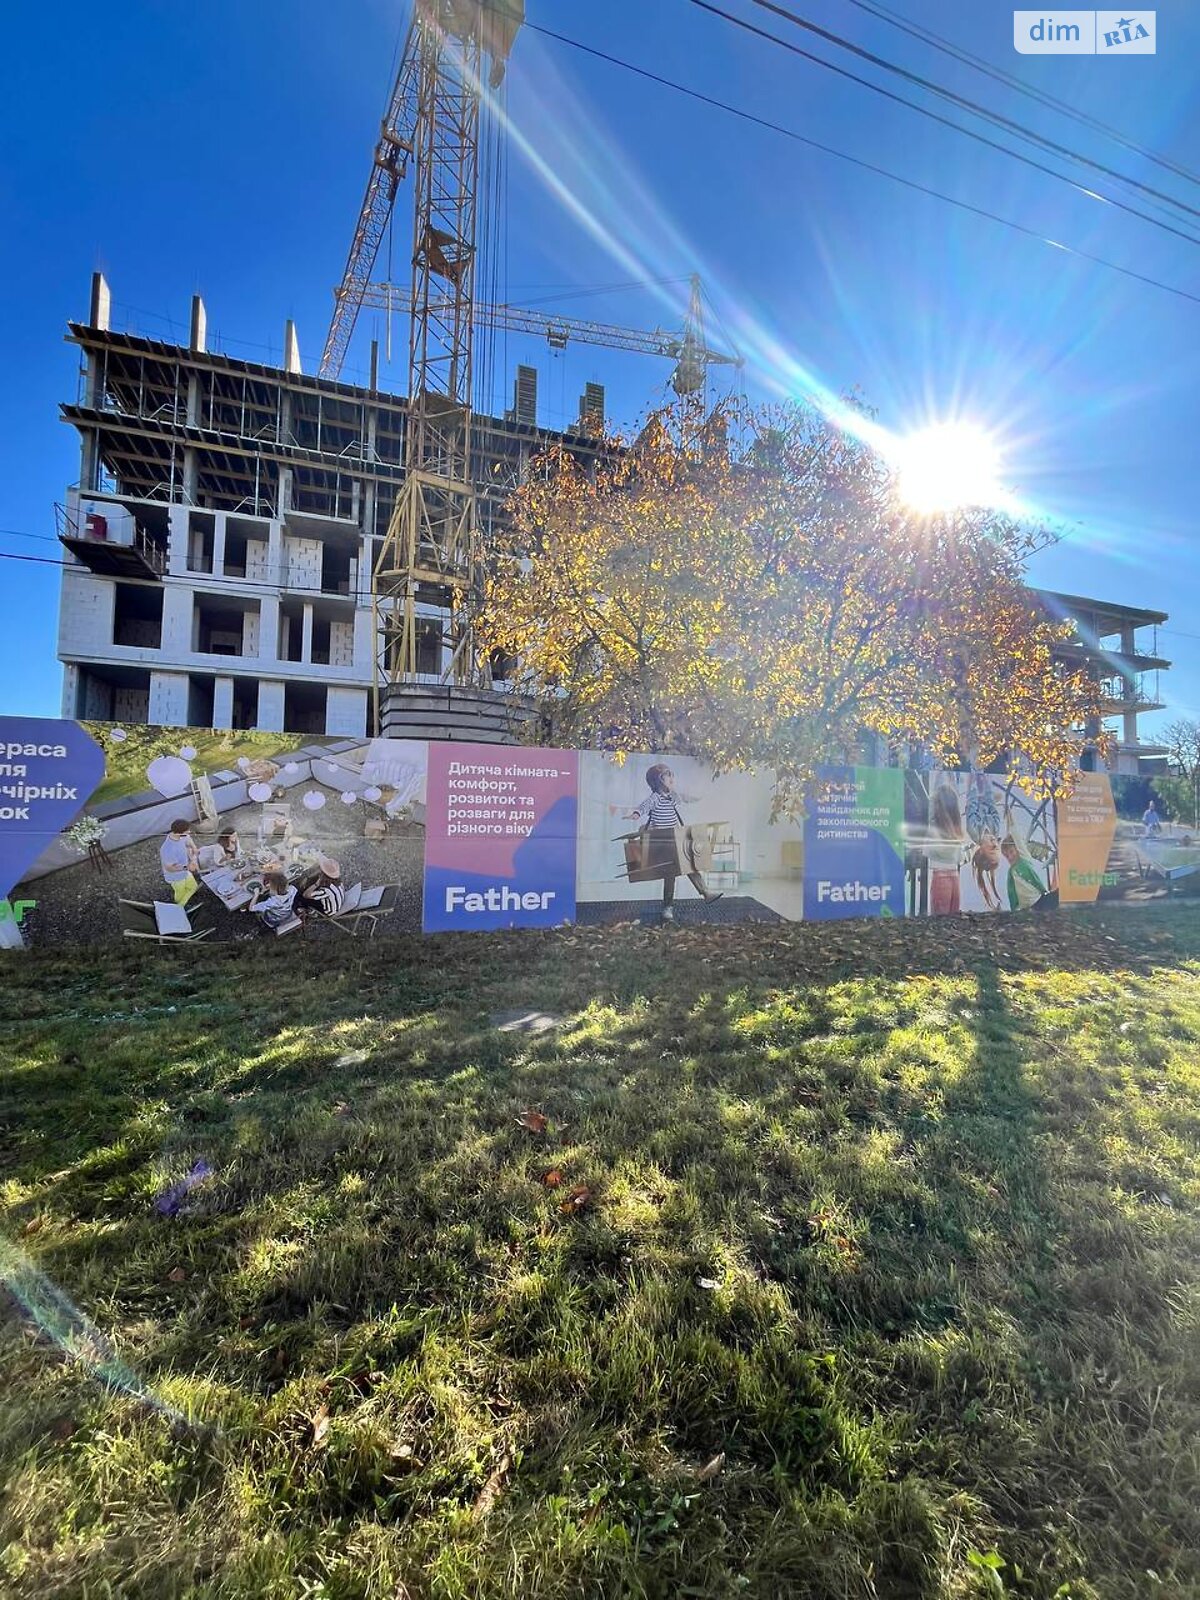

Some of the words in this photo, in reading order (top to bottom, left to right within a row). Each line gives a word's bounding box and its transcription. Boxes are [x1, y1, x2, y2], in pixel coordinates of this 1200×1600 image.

[448, 762, 501, 777] Дитяча
[505, 764, 558, 778] кімната
[0, 781, 78, 804] чірніх
[449, 778, 517, 793] комфорт,
[448, 793, 516, 807] розвиток
[519, 797, 535, 806] та
[448, 808, 506, 821] розваги
[509, 811, 535, 821] для
[817, 804, 871, 815] майданчик
[873, 807, 890, 816] для
[448, 821, 502, 836] різного
[505, 822, 534, 837] віку
[817, 830, 869, 840] дитинства
[1068, 868, 1121, 887] Father
[445, 886, 556, 913] Father
[817, 881, 892, 903] Father
